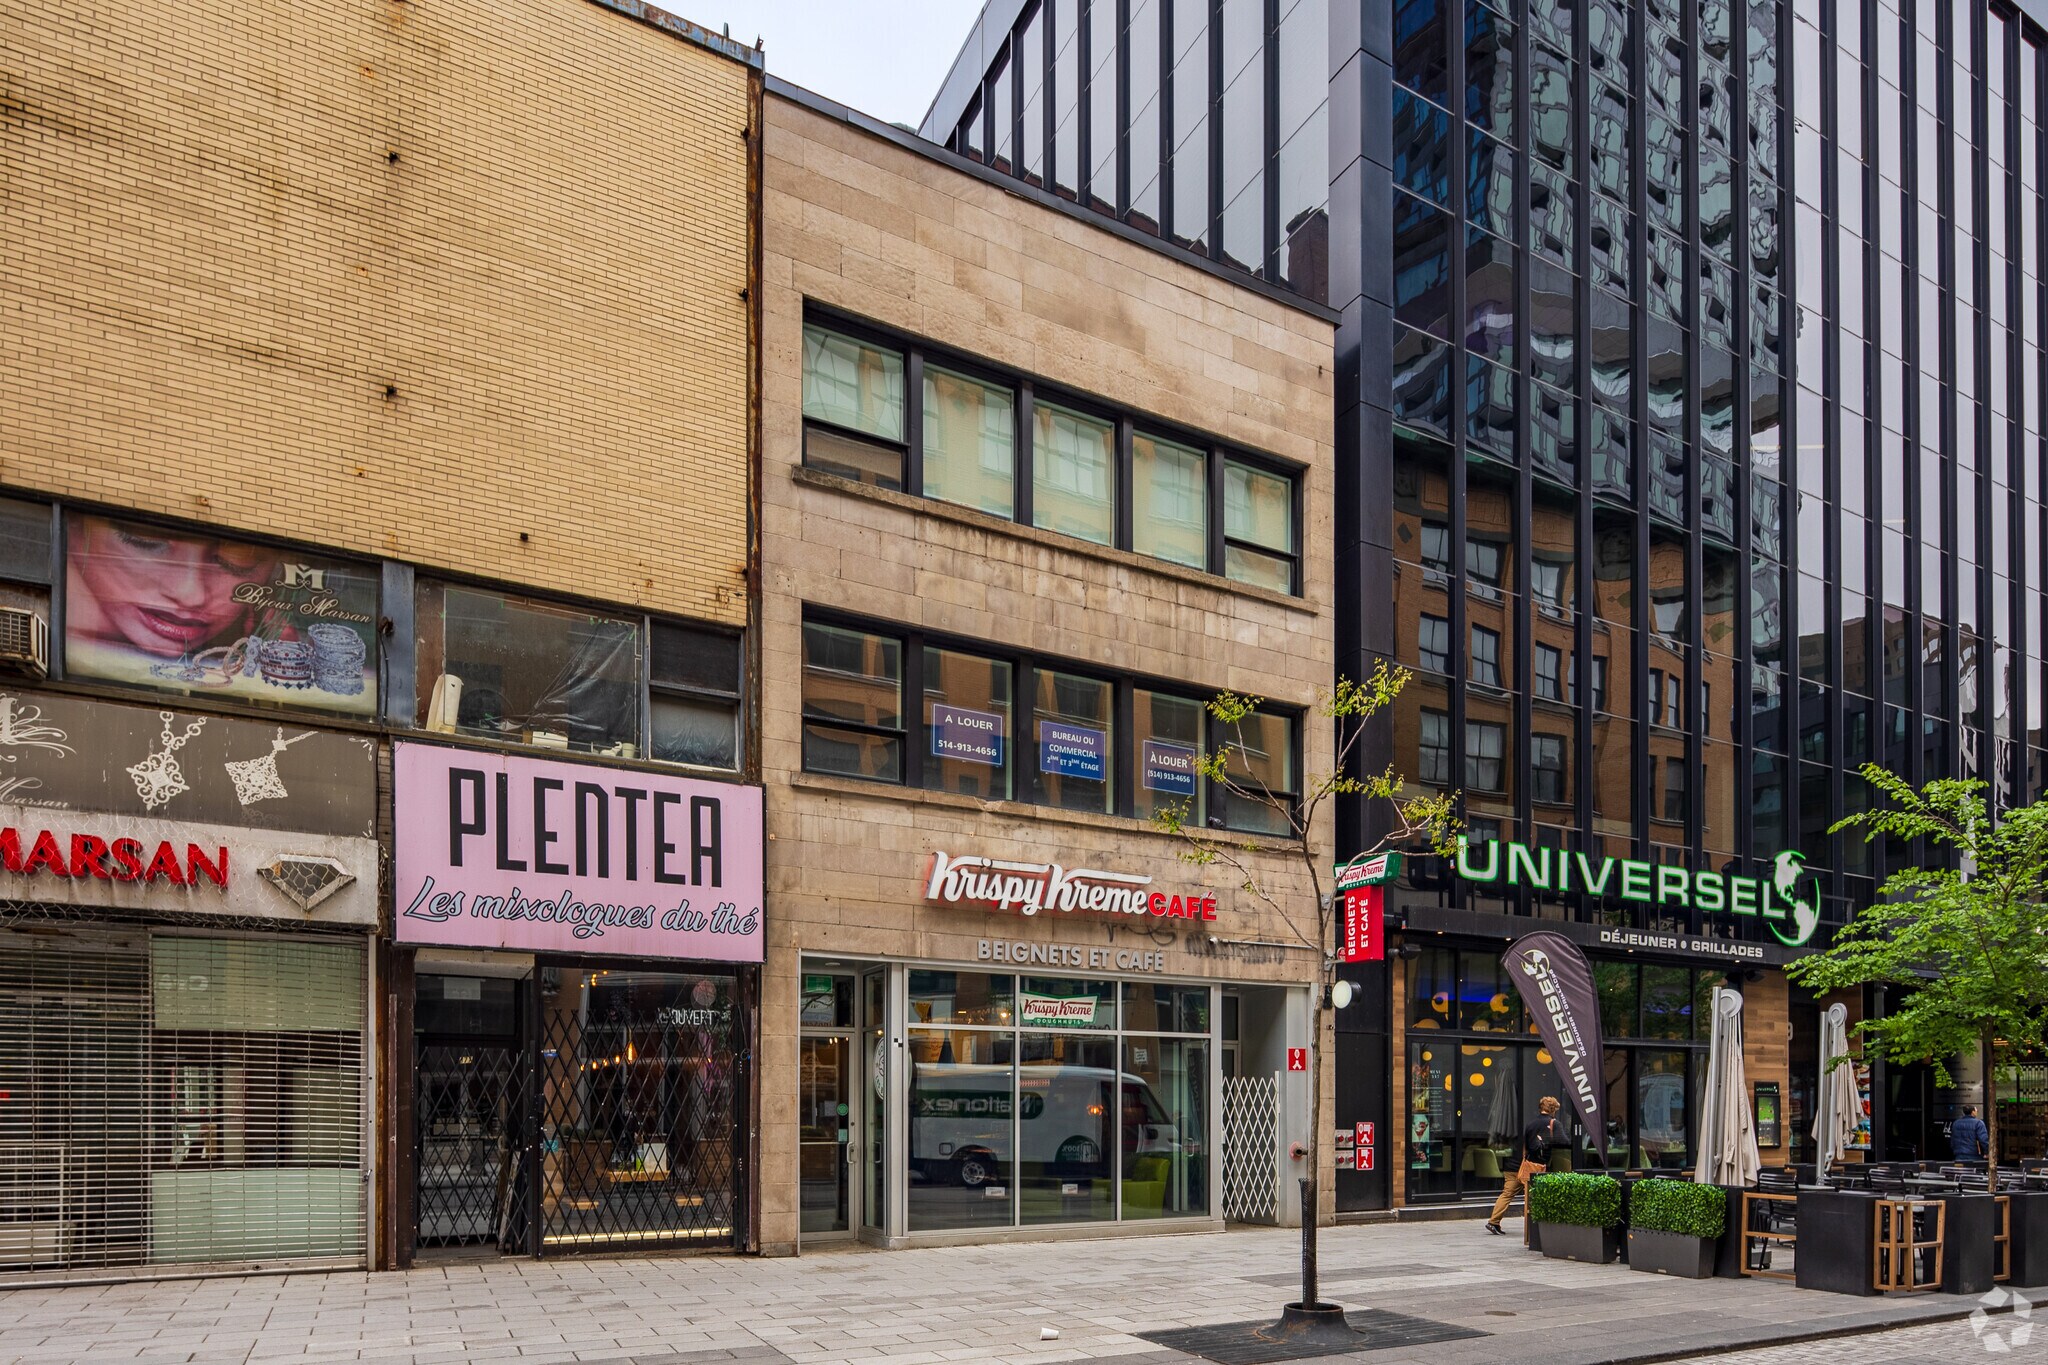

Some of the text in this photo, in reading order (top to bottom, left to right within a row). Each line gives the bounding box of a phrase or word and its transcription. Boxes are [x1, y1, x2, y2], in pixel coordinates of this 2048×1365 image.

[232, 582, 372, 624] Bijoux Marsan
[944, 714, 994, 732] A LOUER
[1052, 731, 1095, 745] BUREAU OU
[938, 739, 998, 757] 514-913-4656
[1048, 743, 1098, 759] COMMERCIAL
[1150, 751, 1188, 769] À LOUER
[1080, 761, 1100, 771] ÉTAGE
[1147, 769, 1191, 784] (514) 913-4656
[449, 767, 722, 888] PLENTEA
[1360, 860, 1385, 878] Kreme
[1456, 834, 1787, 919] UNIVERSEL
[927, 851, 1218, 921] Krispy Kreme CAFÉ
[403, 875, 760, 939] Les mixologues du thé
[1347, 896, 1356, 956] BEIGNETS
[1358, 898, 1369, 948] ET CAFÉ
[977, 939, 1164, 972] BEIGNETS ET CAFÉ
[1600, 928, 1764, 958] DÉJEUNER GRILLADES
[1023, 999, 1094, 1017] Krispy Kreme
[1536, 965, 1598, 1113] UNIVERSEL
